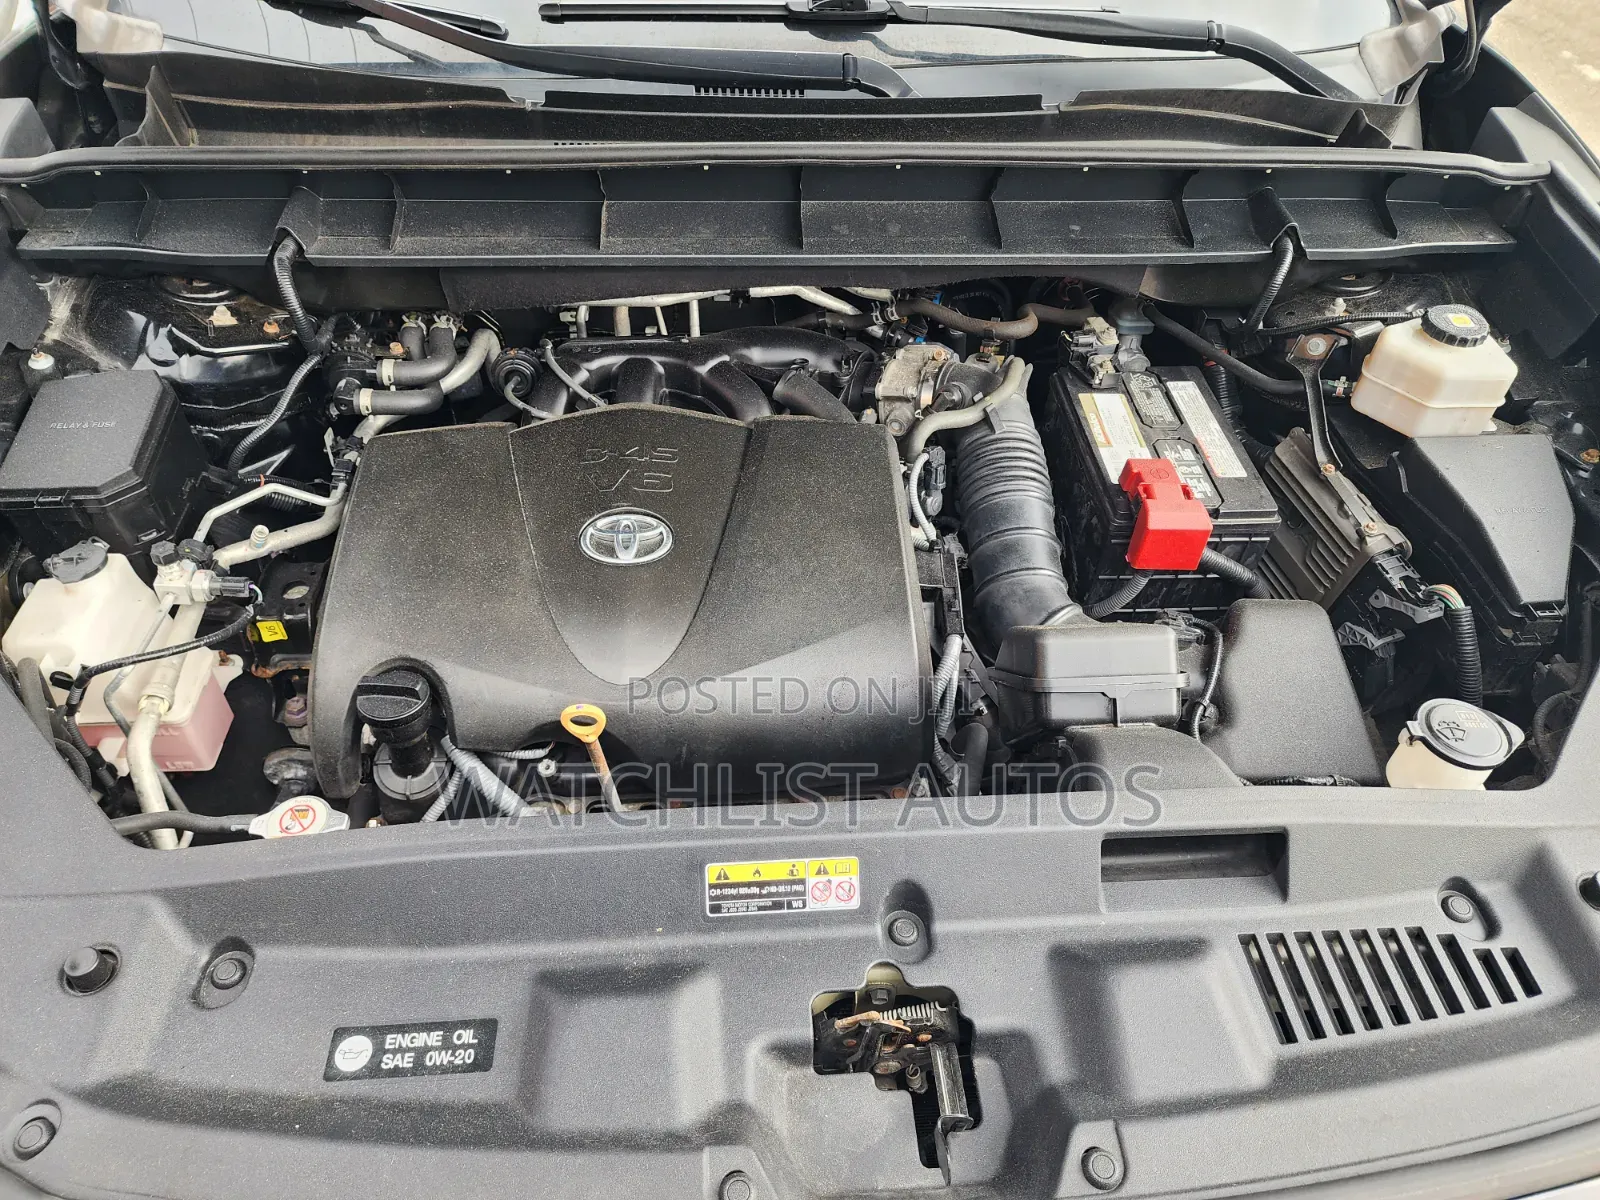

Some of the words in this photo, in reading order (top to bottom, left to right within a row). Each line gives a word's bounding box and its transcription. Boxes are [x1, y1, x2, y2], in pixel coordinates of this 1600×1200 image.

[91, 420, 117, 428] FUSE
[585, 469, 674, 492] V6
[384, 1031, 443, 1050] ENGINE
[453, 1029, 478, 1045] OIL
[380, 1052, 415, 1070] SAE
[425, 1049, 475, 1067] 0W-20
